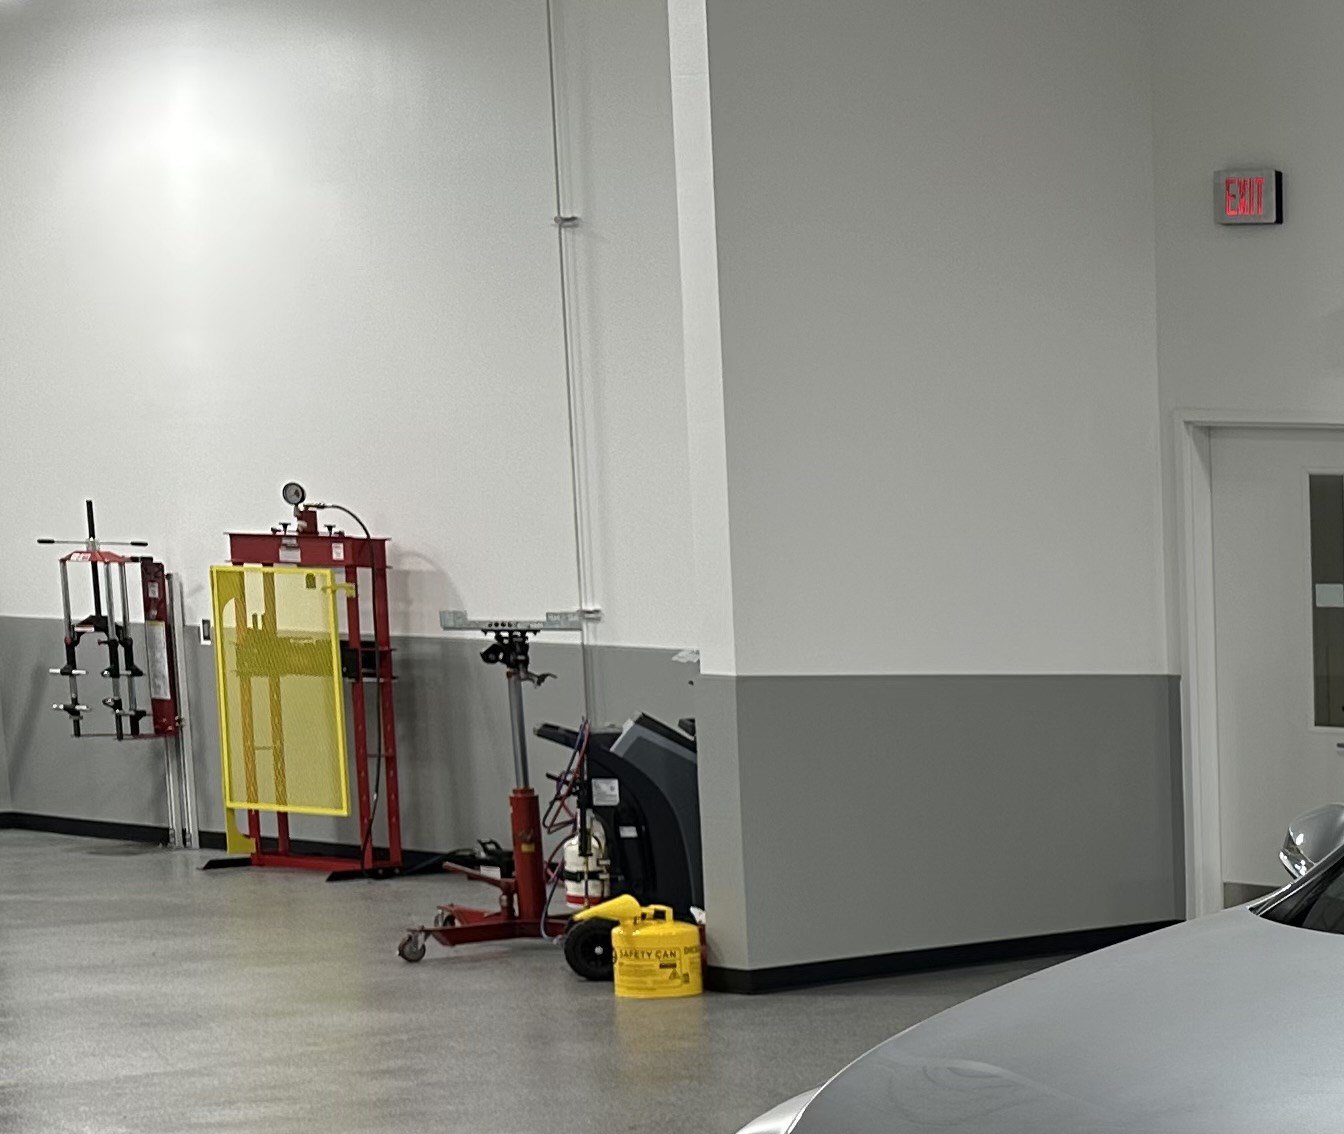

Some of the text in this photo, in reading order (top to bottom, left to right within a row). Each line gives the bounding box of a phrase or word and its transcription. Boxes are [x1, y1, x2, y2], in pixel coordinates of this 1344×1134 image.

[1224, 177, 1265, 217] EXIT
[619, 949, 653, 960] SAFETY
[655, 949, 677, 960] CAN
